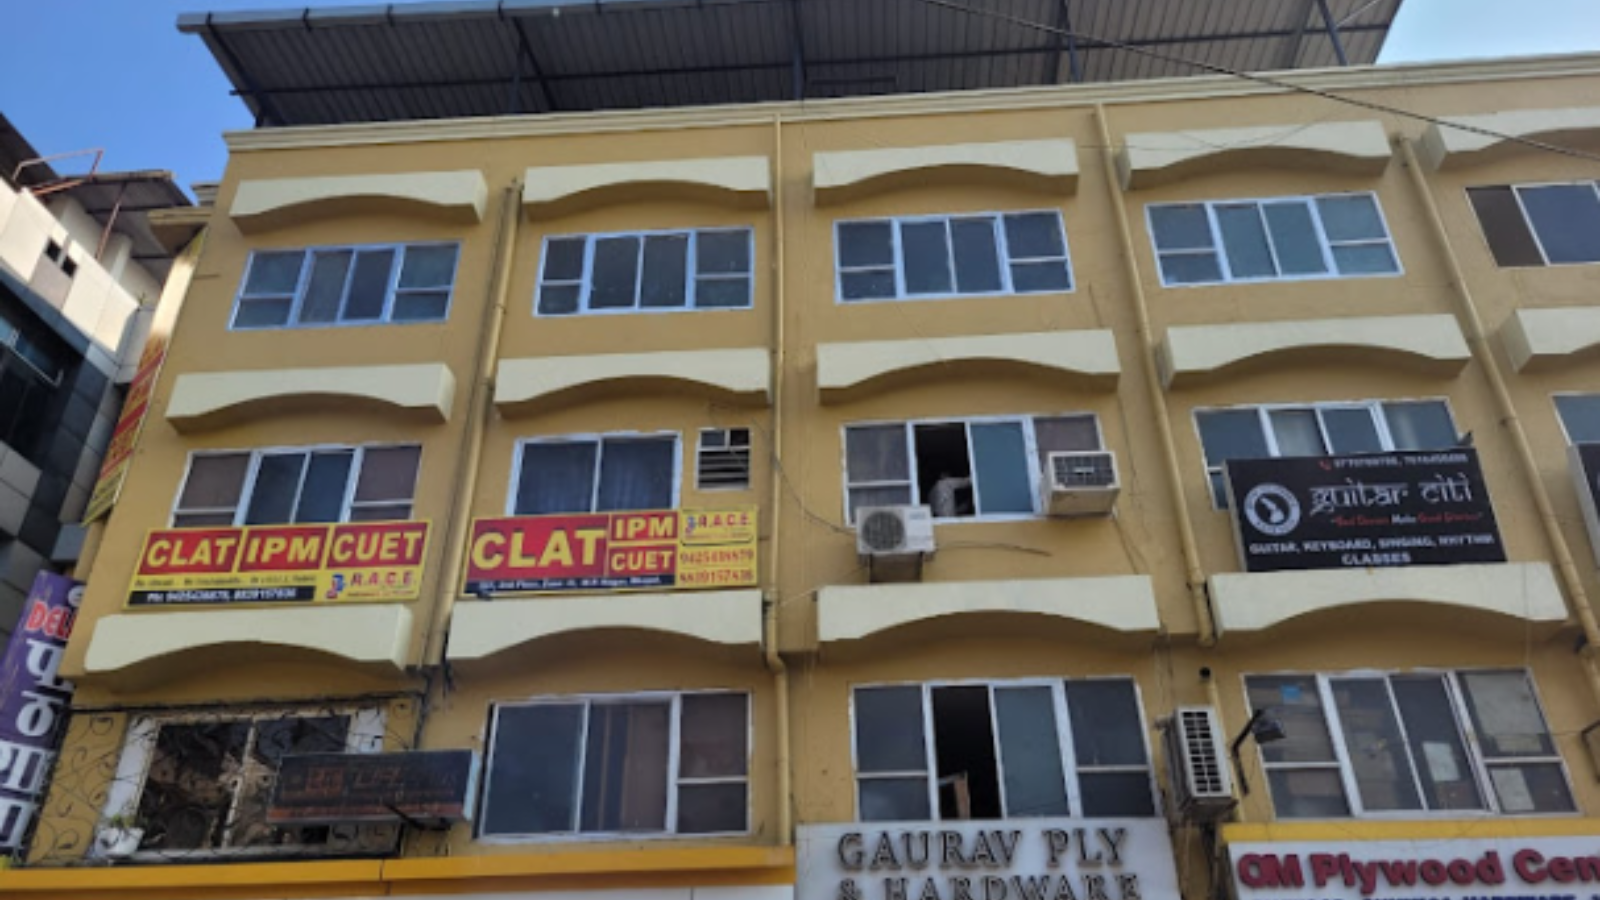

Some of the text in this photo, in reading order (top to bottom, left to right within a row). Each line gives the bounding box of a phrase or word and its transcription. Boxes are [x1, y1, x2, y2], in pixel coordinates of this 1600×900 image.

[615, 516, 674, 539] IPM
[147, 530, 423, 567] CLAT IPM CUET
[471, 528, 607, 569] CLAT
[611, 550, 674, 572] CUET
[1341, 552, 1411, 565] CLASSES
[836, 827, 1128, 870] GAURAV PLY
[837, 874, 1142, 900] & HARDWARE
[1308, 850, 1505, 897] Plywood
